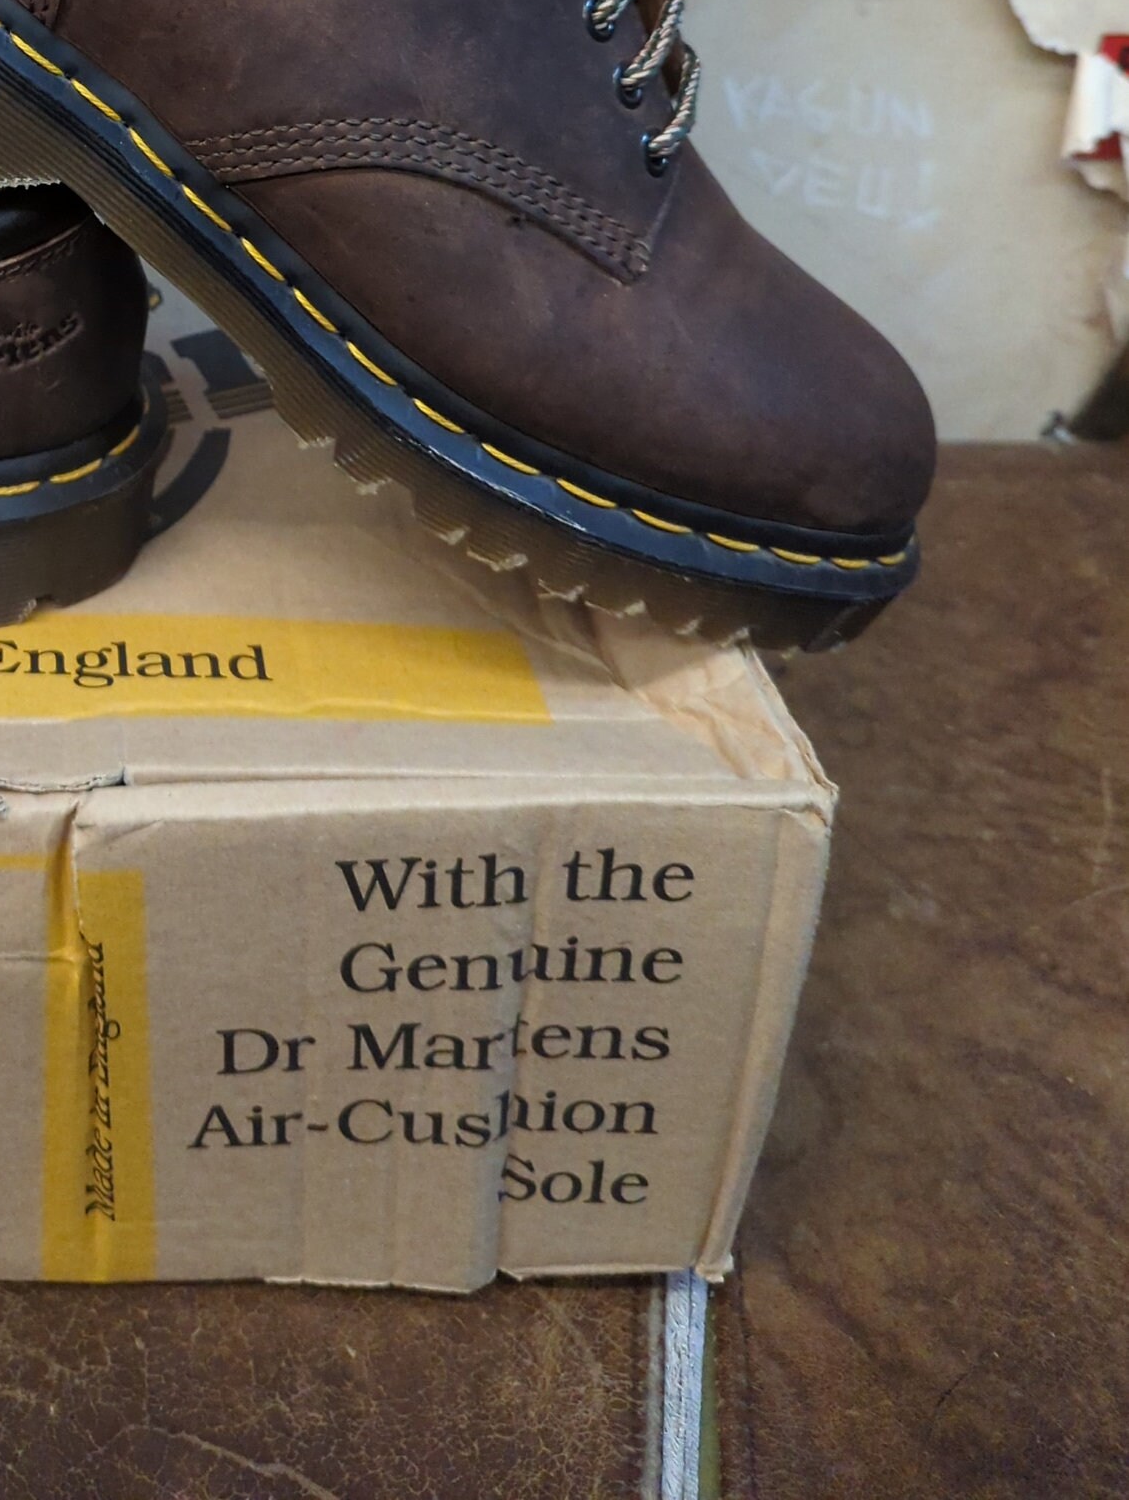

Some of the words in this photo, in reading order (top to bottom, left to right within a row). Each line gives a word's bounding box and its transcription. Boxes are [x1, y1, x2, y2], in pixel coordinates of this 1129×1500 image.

[335, 852, 530, 912] With
[563, 847, 696, 902] the
[339, 935, 684, 992] Genuine
[217, 1027, 315, 1075] Dr
[347, 1011, 671, 1072] Martens
[187, 1089, 658, 1150] Air-Cushion
[498, 1152, 650, 1204] Sole
